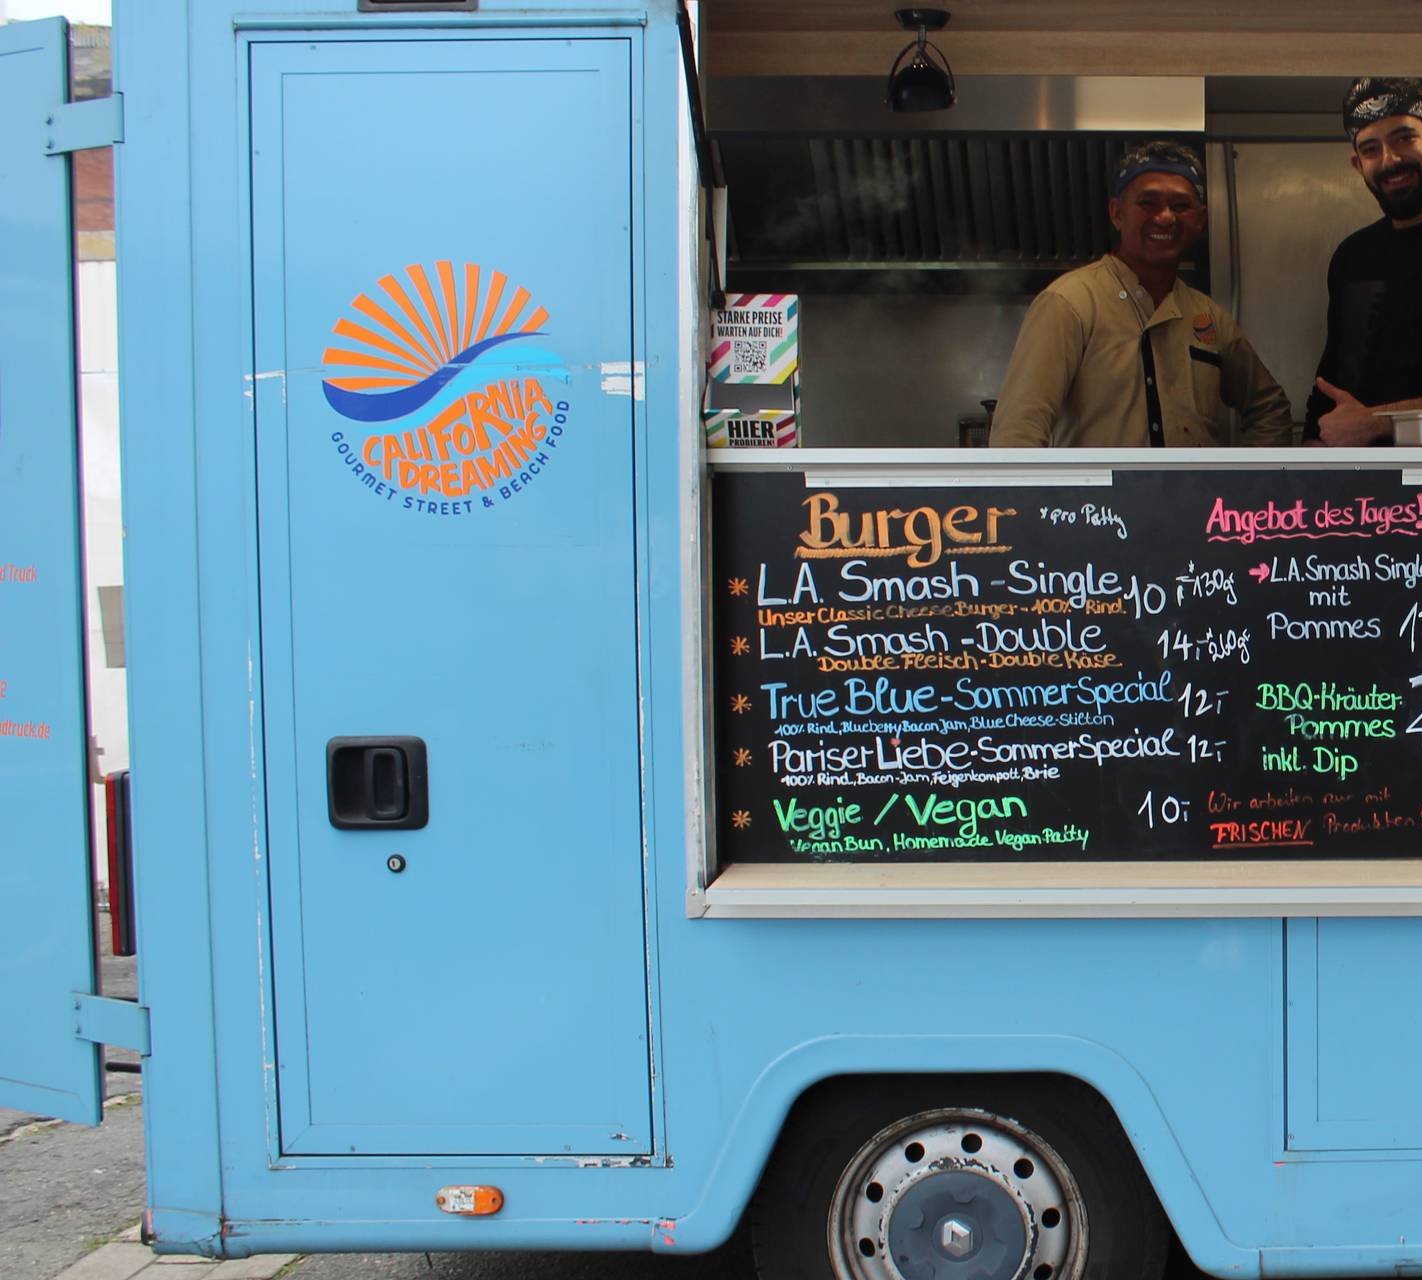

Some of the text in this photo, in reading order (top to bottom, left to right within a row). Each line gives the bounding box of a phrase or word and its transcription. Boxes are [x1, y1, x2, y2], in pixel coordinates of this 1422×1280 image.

[717, 310, 783, 325] STARKE PREISE
[717, 326, 783, 338] WARTEN AUF DICH!
[363, 378, 554, 480] CALIFORNIA
[727, 420, 775, 438] HIER
[331, 400, 570, 515] GOURMET STREET & BEACH FOOD
[397, 411, 547, 497] DREAMING
[799, 492, 1018, 568] Burger
[1205, 497, 1354, 544] Angebot des
[757, 560, 980, 606] L.A. Smash
[1305, 554, 1371, 582] Smash
[1309, 585, 1351, 607] mit
[1267, 611, 1382, 640] Pommes
[760, 623, 950, 660] L.A. Smash
[816, 655, 900, 672] Double
[760, 682, 840, 720] True
[1285, 713, 1397, 740] Pommes
[768, 740, 875, 774] Pariser
[1262, 746, 1358, 780] inkl. Dip
[1208, 790, 1243, 813] Wir
[1249, 787, 1313, 810] arbeiten
[1365, 787, 1392, 803] mit
[773, 793, 1028, 840] Veggie Vegan
[1210, 819, 1313, 843] FRISCHEN
[892, 832, 993, 851] Homemade
